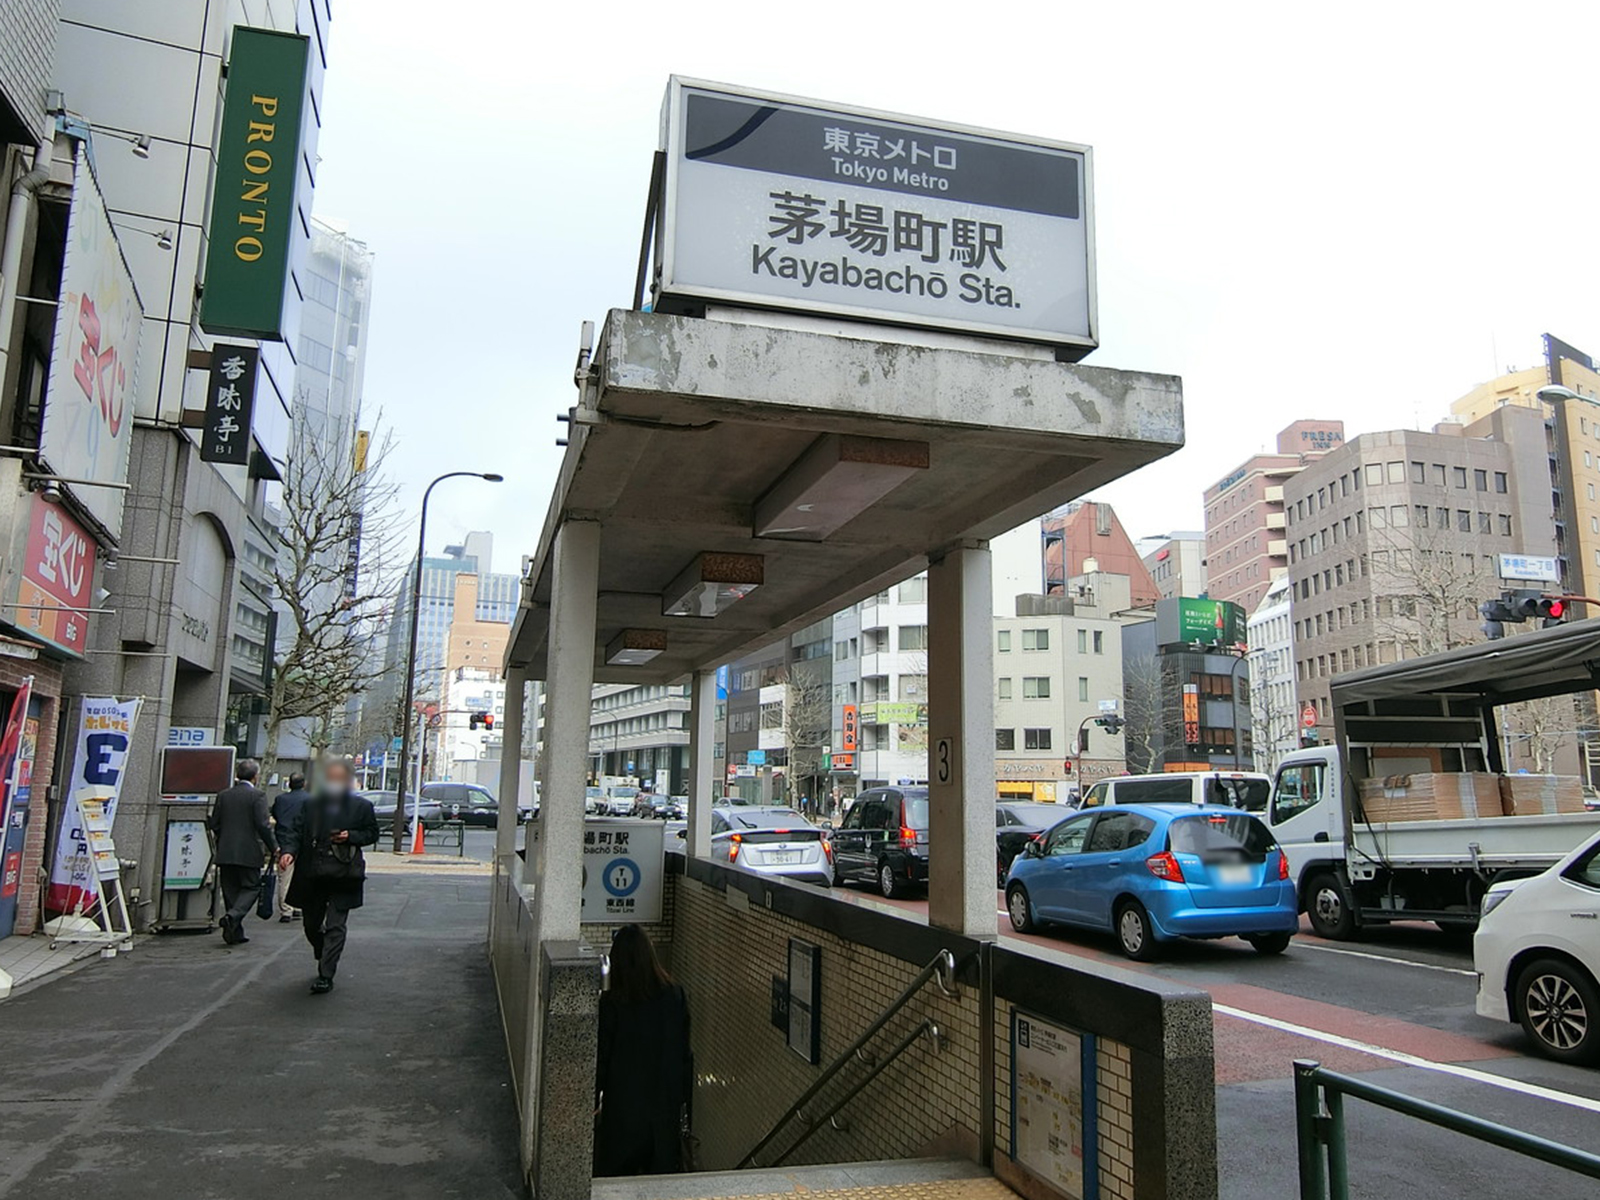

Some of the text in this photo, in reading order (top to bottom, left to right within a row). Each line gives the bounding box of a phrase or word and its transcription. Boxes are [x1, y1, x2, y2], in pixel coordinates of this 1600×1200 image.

[823, 127, 957, 170] 東京メトロ
[235, 94, 278, 262] PRONTO
[831, 156, 949, 191] Tokyo Metro
[768, 190, 1008, 273] 茅場町駅
[752, 243, 1021, 309] Kayabachō Sta.
[213, 356, 246, 442] 香味亭
[38, 510, 86, 597] 宝くじ
[66, 622, 77, 642] BIG
[168, 729, 205, 742] ena
[938, 740, 949, 782] 3
[613, 846, 630, 854] Sta.
[616, 878, 627, 887] 11
[619, 868, 625, 877] T
